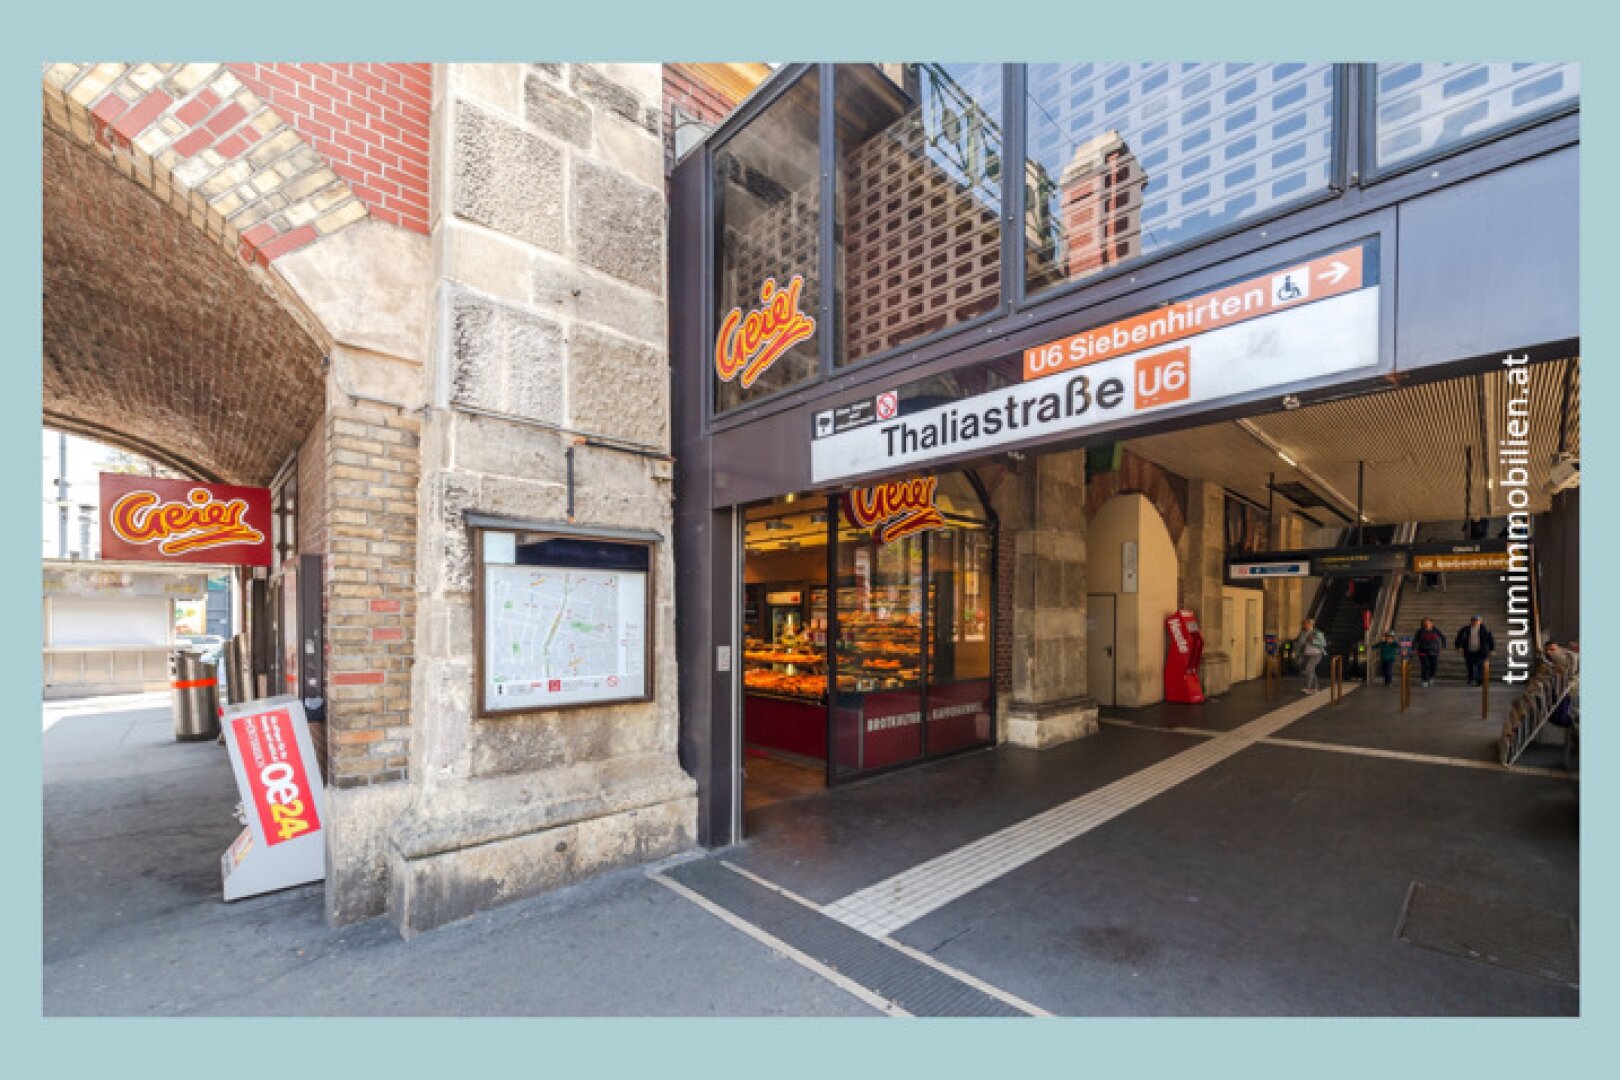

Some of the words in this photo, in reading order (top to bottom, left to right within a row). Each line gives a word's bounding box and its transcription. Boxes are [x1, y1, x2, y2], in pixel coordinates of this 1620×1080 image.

[716, 275, 816, 388] Geier
[1028, 346, 1063, 373] U6
[1068, 287, 1264, 363] Siebenhirten
[881, 374, 1125, 456] Thaliastraße
[1137, 360, 1187, 397] U6
[111, 487, 264, 555] Geier
